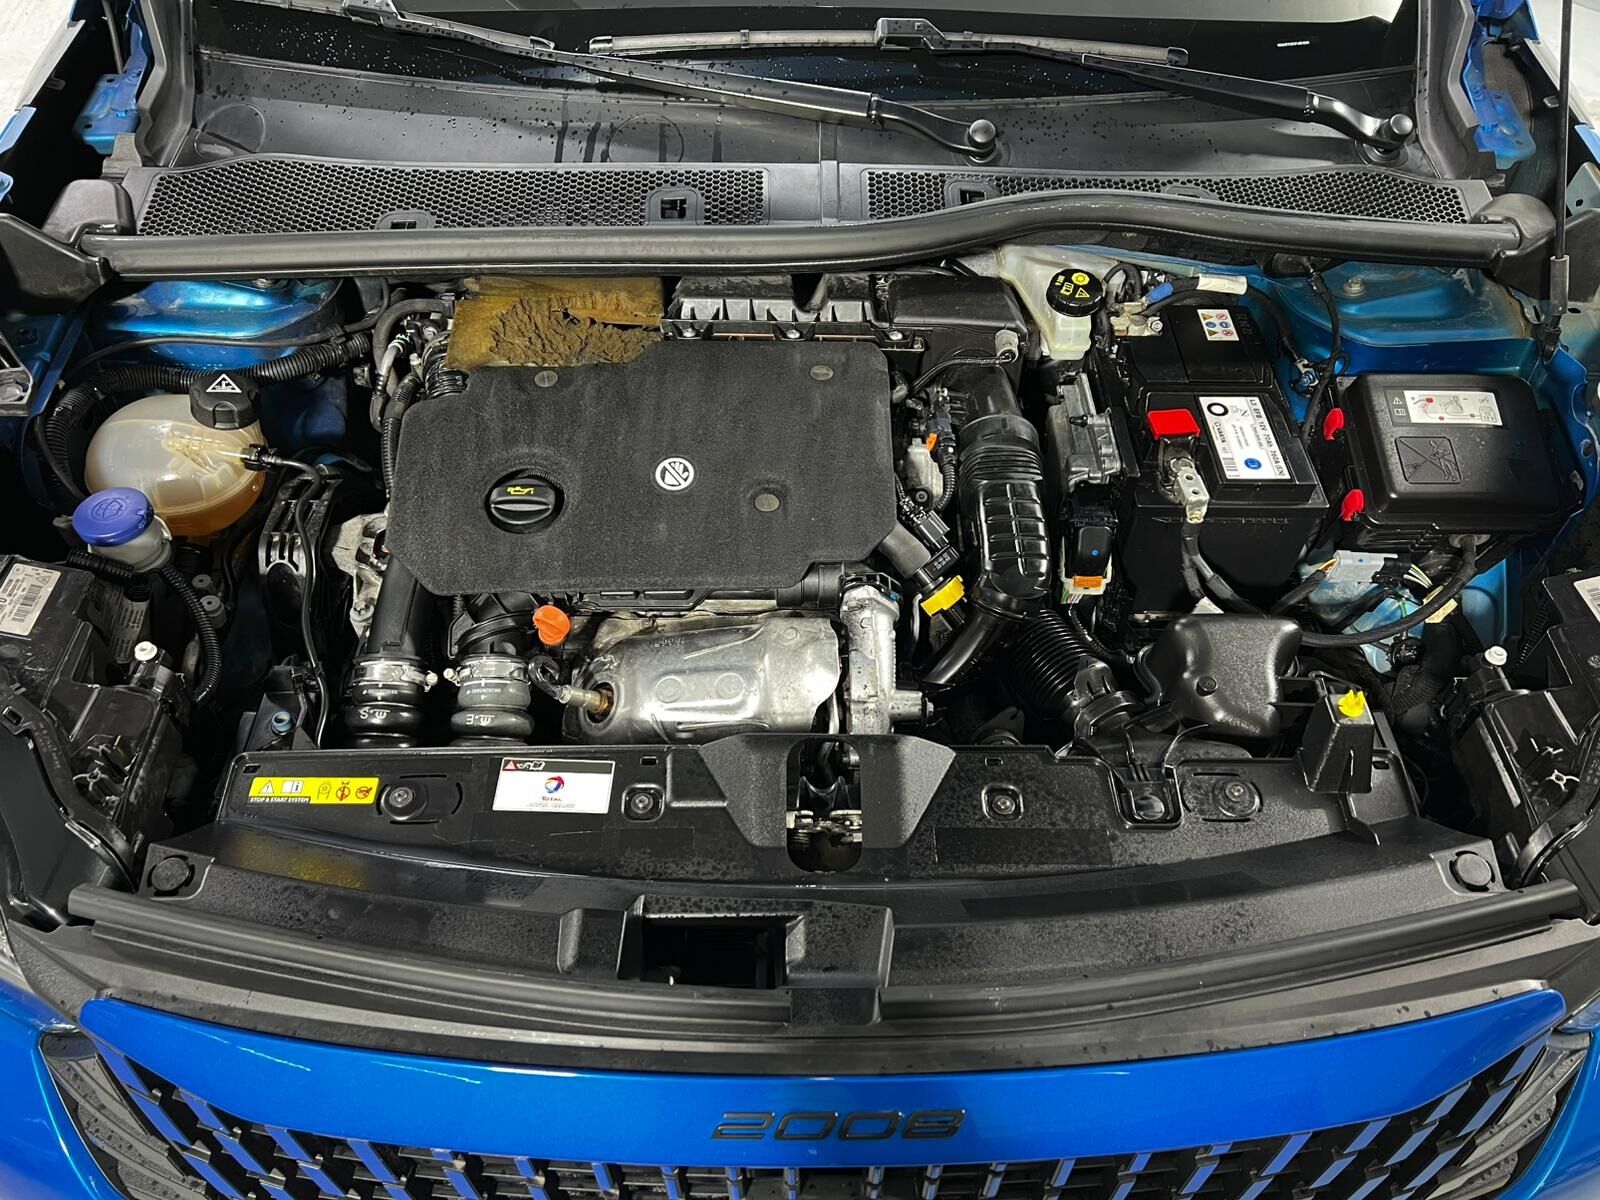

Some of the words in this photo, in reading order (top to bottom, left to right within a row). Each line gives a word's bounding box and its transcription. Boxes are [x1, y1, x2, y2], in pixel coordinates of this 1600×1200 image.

[1253, 408, 1263, 419] EFB
[1259, 421, 1268, 432] 12V
[1263, 434, 1274, 448] 70Ah
[711, 1109, 967, 1141] 2008
